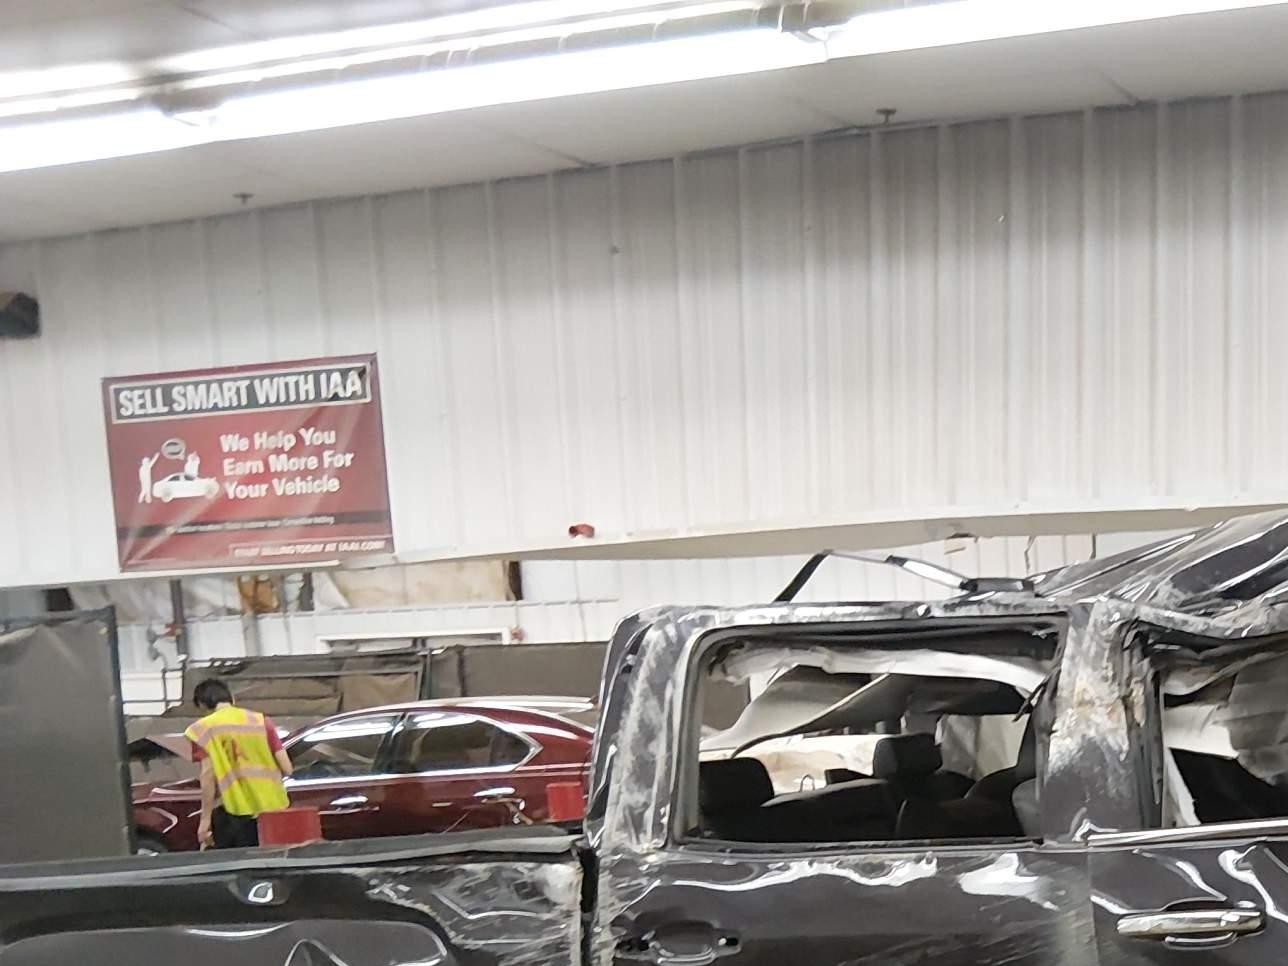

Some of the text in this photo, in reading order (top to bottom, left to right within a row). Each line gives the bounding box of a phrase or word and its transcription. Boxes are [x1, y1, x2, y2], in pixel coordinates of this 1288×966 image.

[119, 370, 362, 416] SELL SMART WITH IAA
[220, 427, 336, 452] We Help You
[223, 450, 354, 476] Earn More For
[225, 475, 340, 499] Your Vehicle
